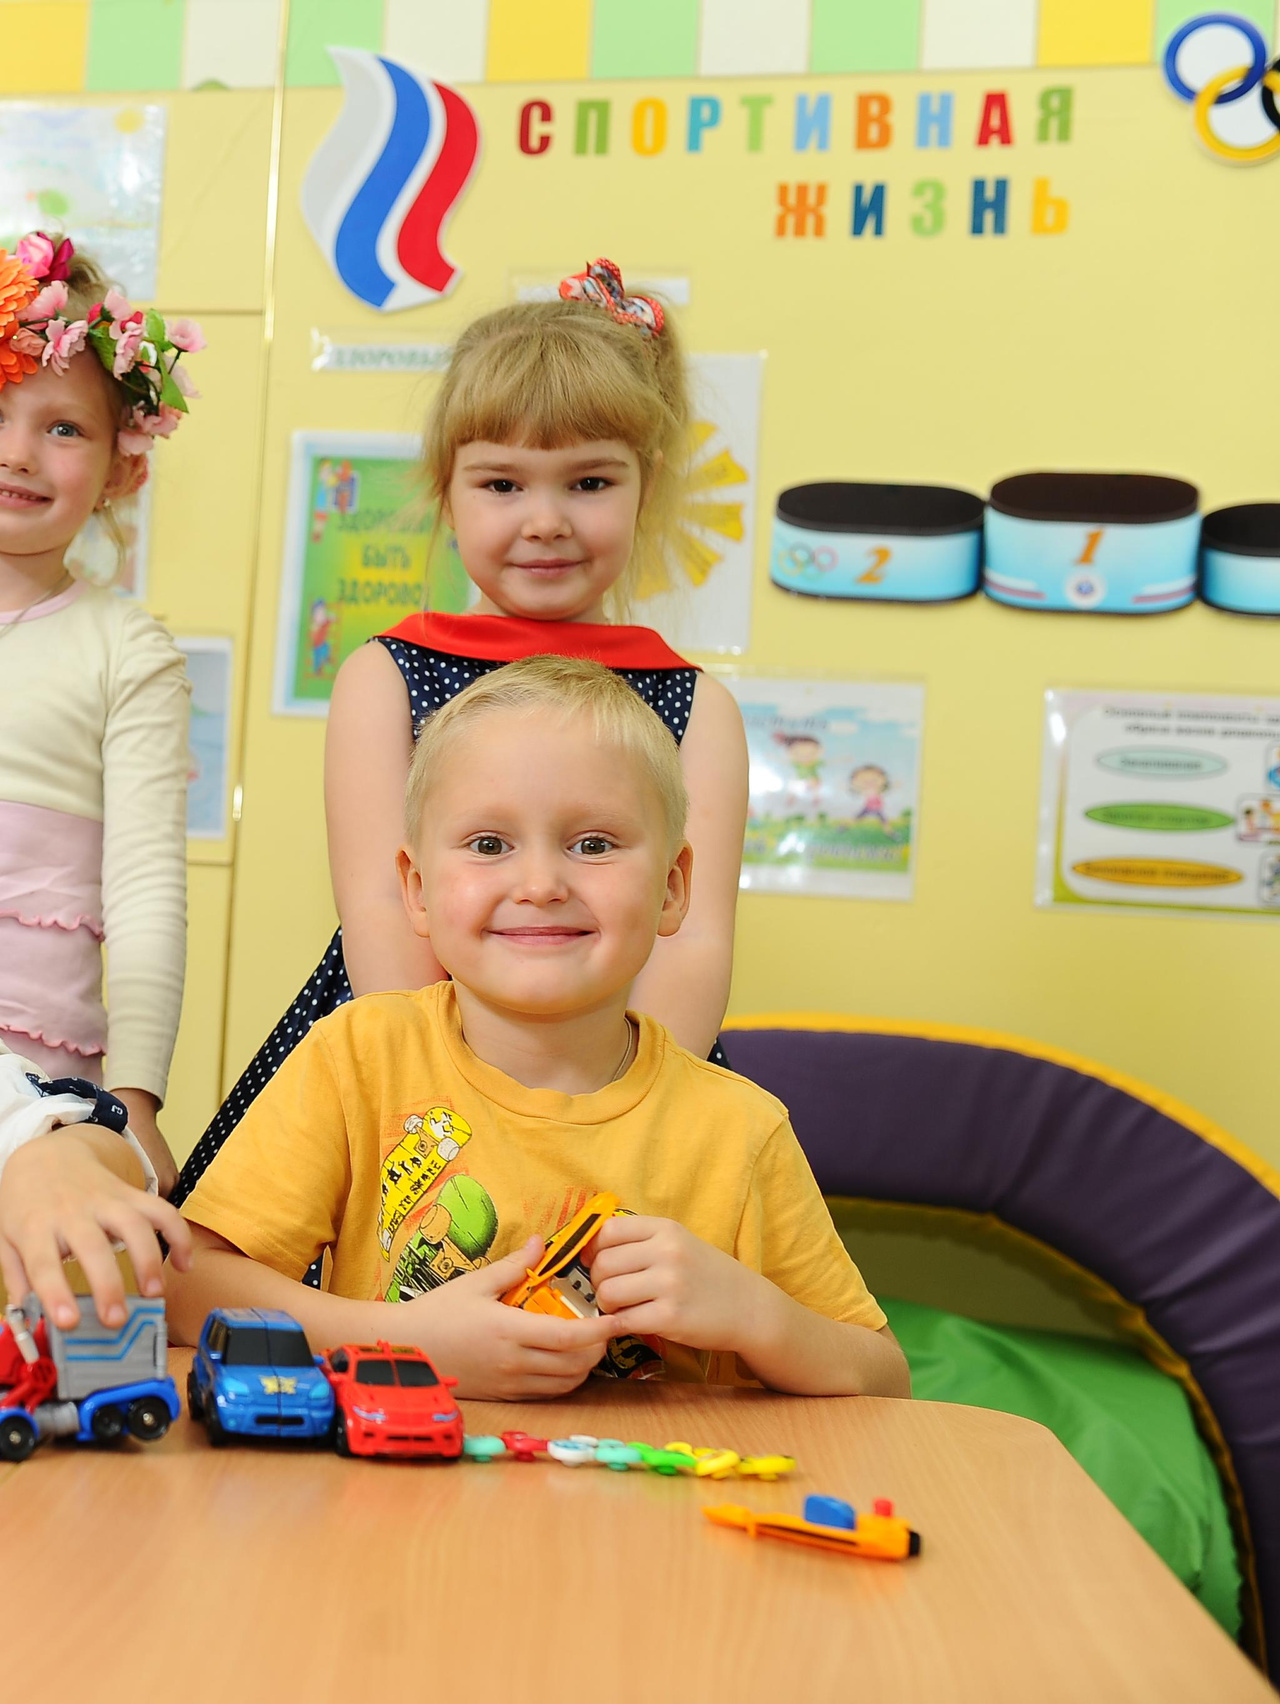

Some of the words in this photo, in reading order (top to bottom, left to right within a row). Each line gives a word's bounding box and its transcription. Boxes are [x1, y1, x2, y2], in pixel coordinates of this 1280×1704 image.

[517, 85, 1075, 156] СПОРТИВНАЯ
[775, 176, 1070, 238] ЖИЗНЬ
[854, 545, 893, 584] 2
[1075, 526, 1105, 566] 1
